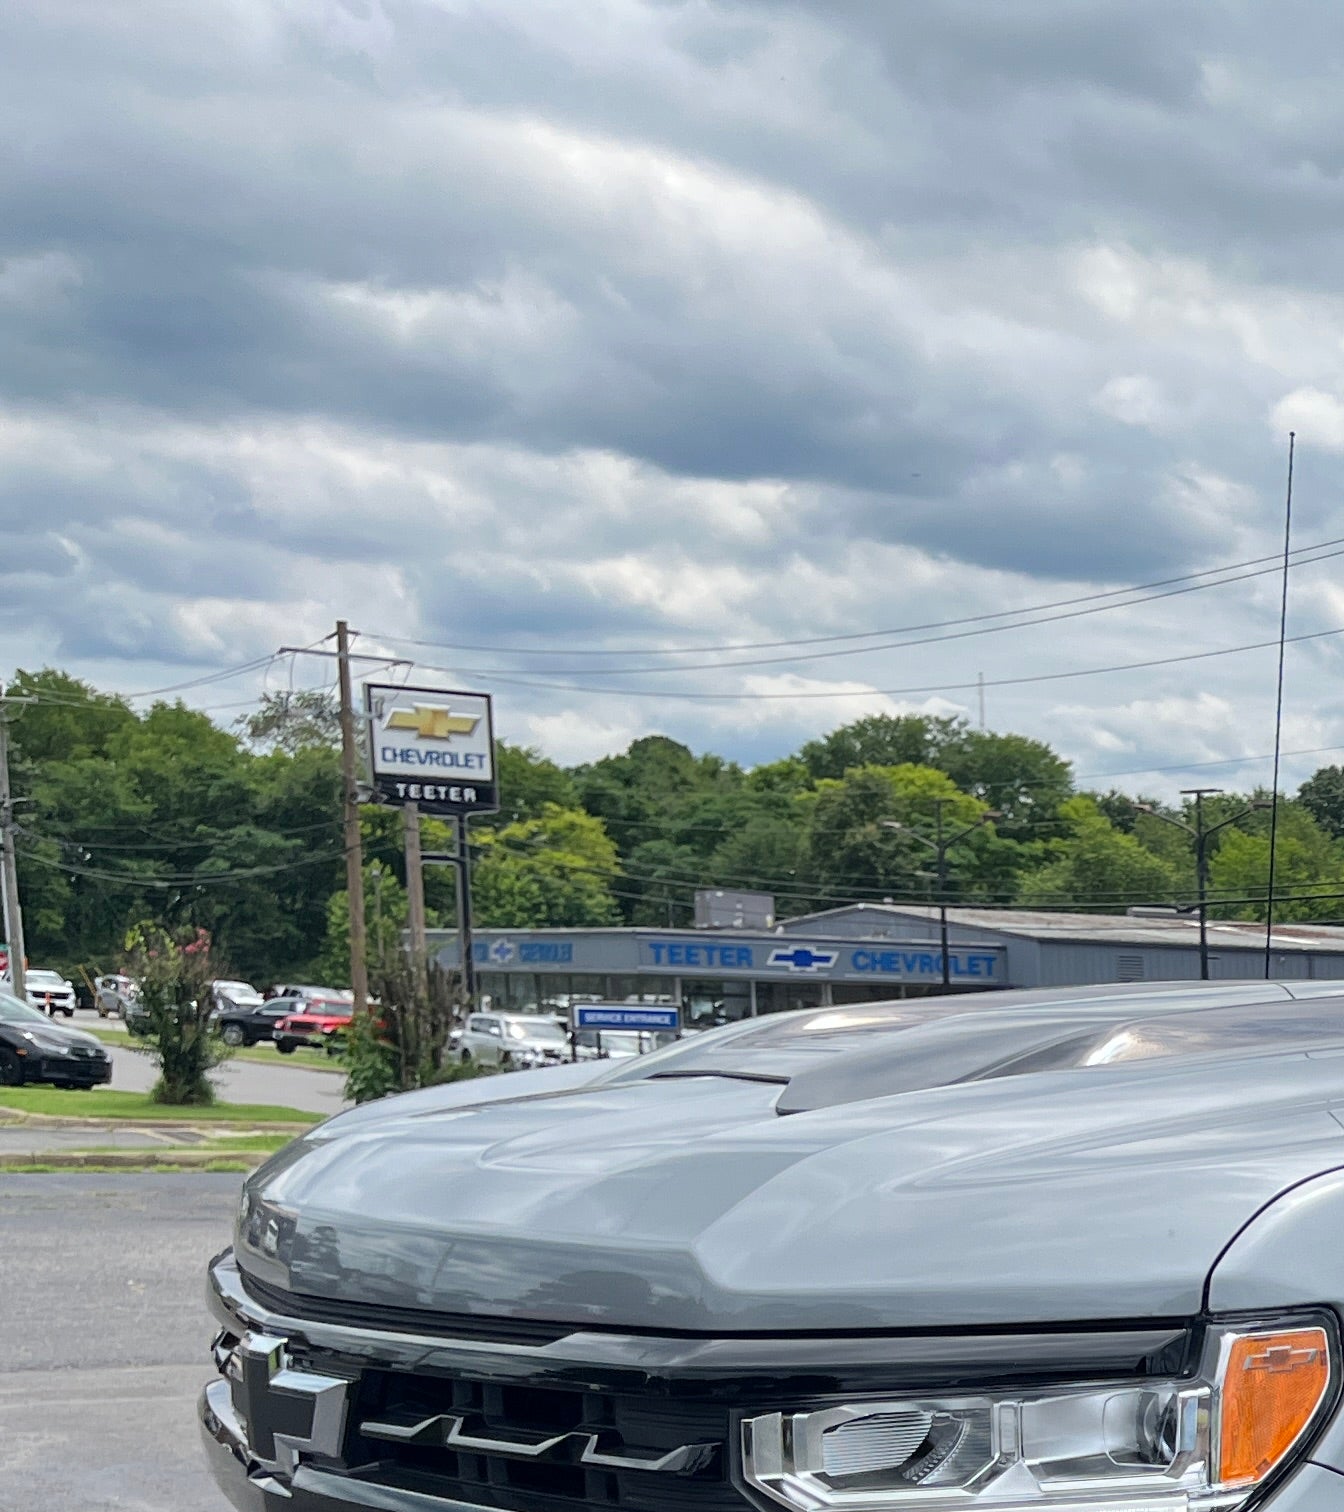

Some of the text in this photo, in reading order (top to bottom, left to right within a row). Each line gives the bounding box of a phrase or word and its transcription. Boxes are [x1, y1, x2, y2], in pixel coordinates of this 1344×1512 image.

[381, 746, 486, 769] CHEVROLET
[395, 782, 477, 803] TEETER
[649, 943, 997, 977] TEETER CHEVROLET
[584, 1012, 622, 1023] SERVICE
